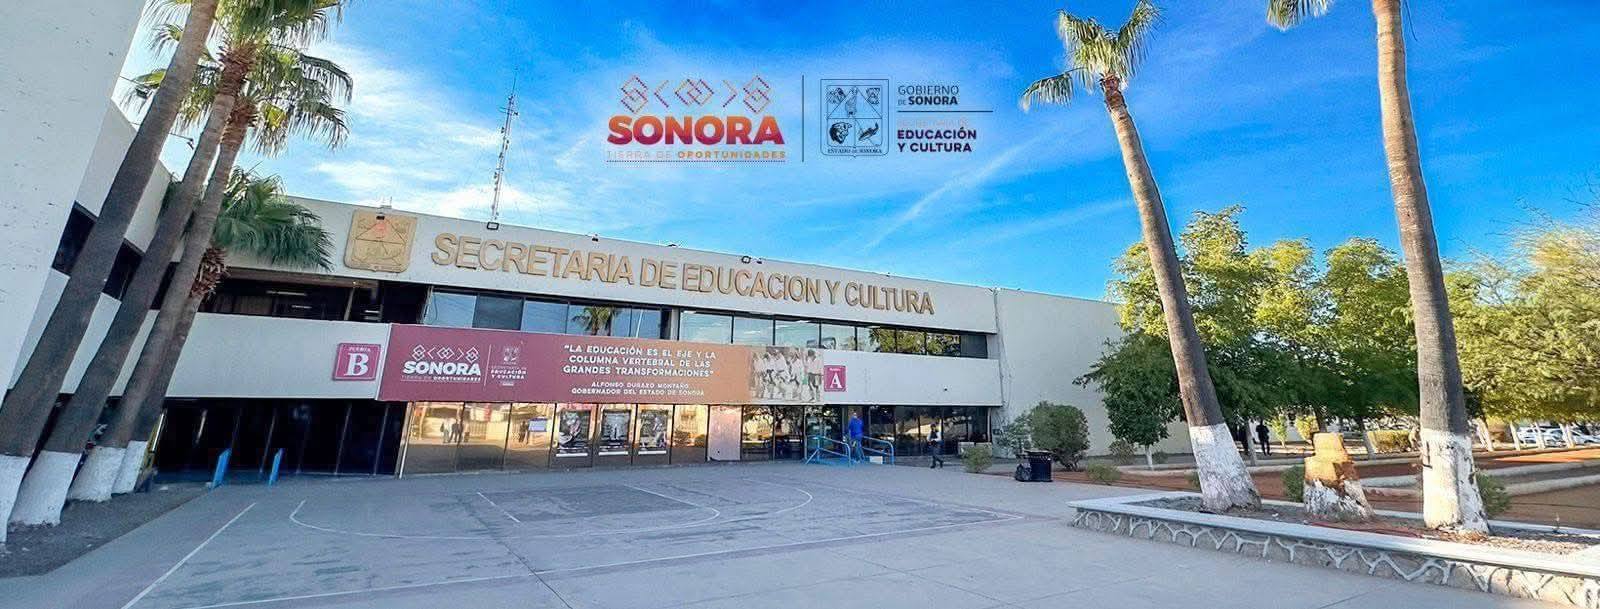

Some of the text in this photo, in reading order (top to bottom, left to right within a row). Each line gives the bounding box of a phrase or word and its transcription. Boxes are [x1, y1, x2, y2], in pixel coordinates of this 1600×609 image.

[430, 232, 935, 315] SECRETARIA DE EDUCACION Y CULTURA
[586, 345, 642, 356] EDUCACIÓN
[647, 348, 658, 356] ES
[662, 349, 673, 357] EL
[677, 350, 692, 358] EJE
[705, 351, 716, 359] LA
[343, 352, 369, 376] B
[402, 361, 481, 376] SONORA
[568, 355, 619, 364] COLUMNA
[622, 357, 675, 367] VERTEBRAL
[694, 360, 711, 368] LAS
[563, 365, 611, 374] GRANDES
[830, 371, 843, 389] A
[571, 387, 621, 395] GOBERNADOR
[639, 388, 665, 396] ESTADO
